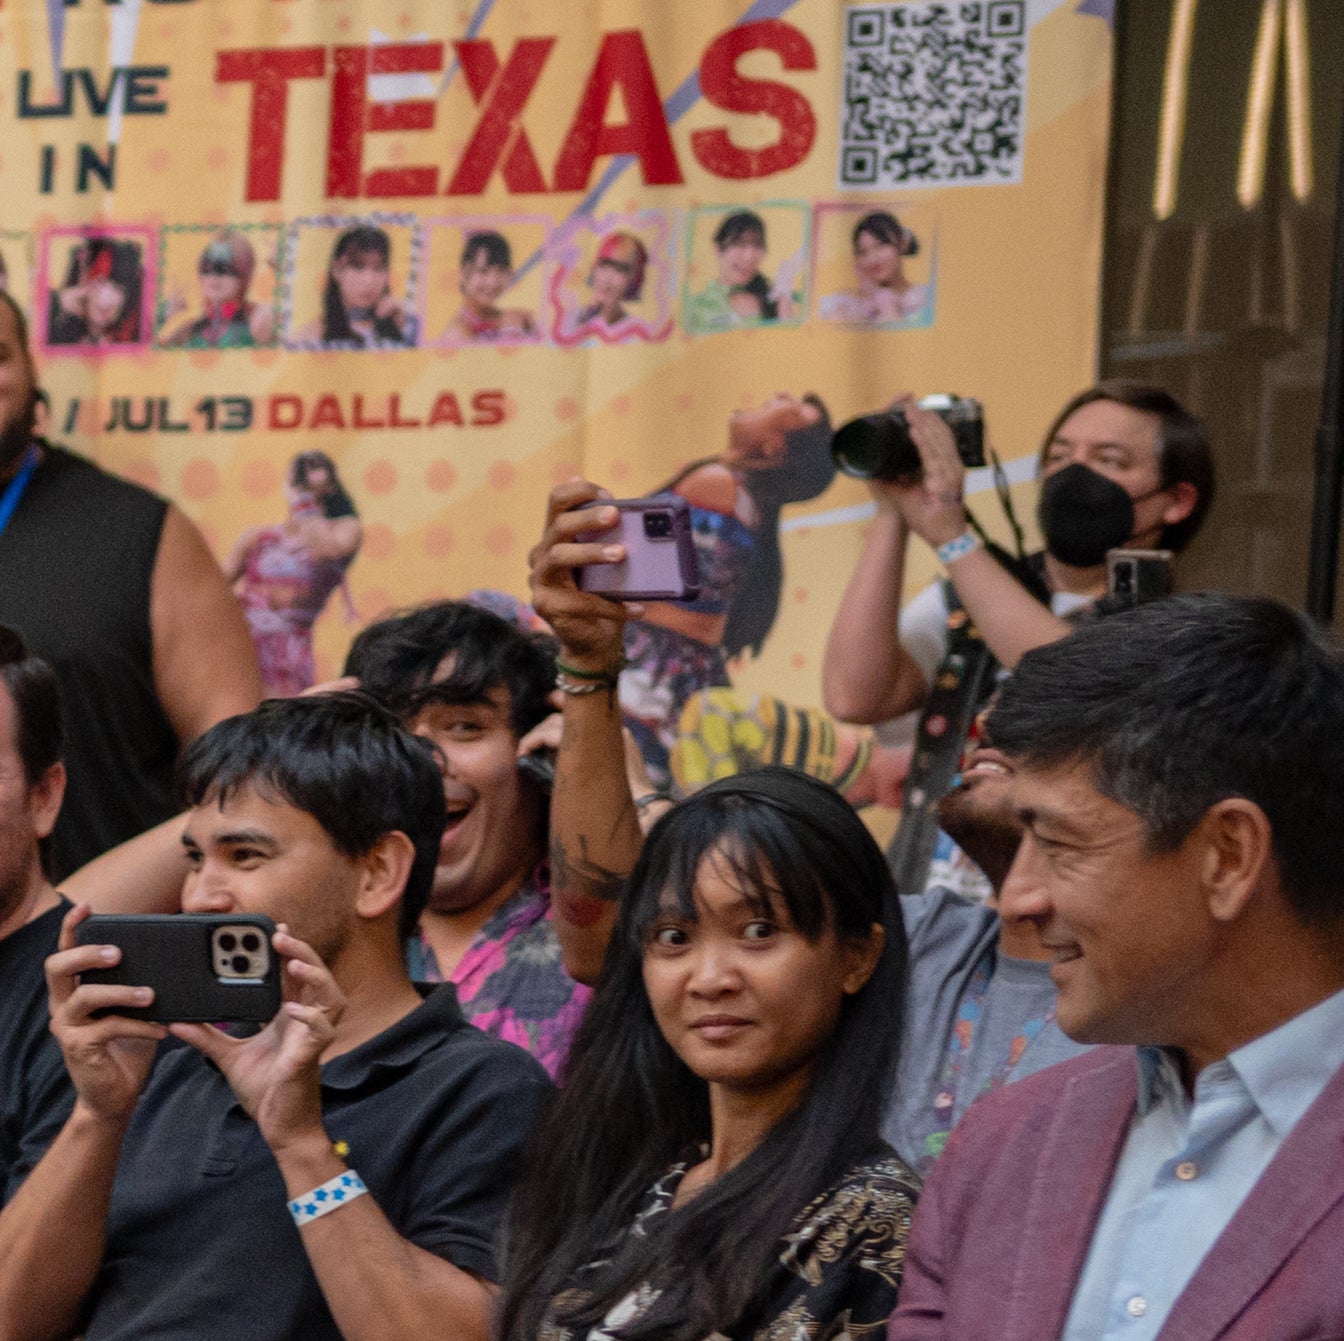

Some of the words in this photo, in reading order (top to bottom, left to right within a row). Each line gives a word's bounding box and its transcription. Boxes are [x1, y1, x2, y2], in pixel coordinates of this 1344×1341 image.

[17, 66, 170, 118] LIVE
[215, 18, 819, 203] TEXAS
[40, 143, 116, 194] IN
[267, 388, 506, 432] DALLAS
